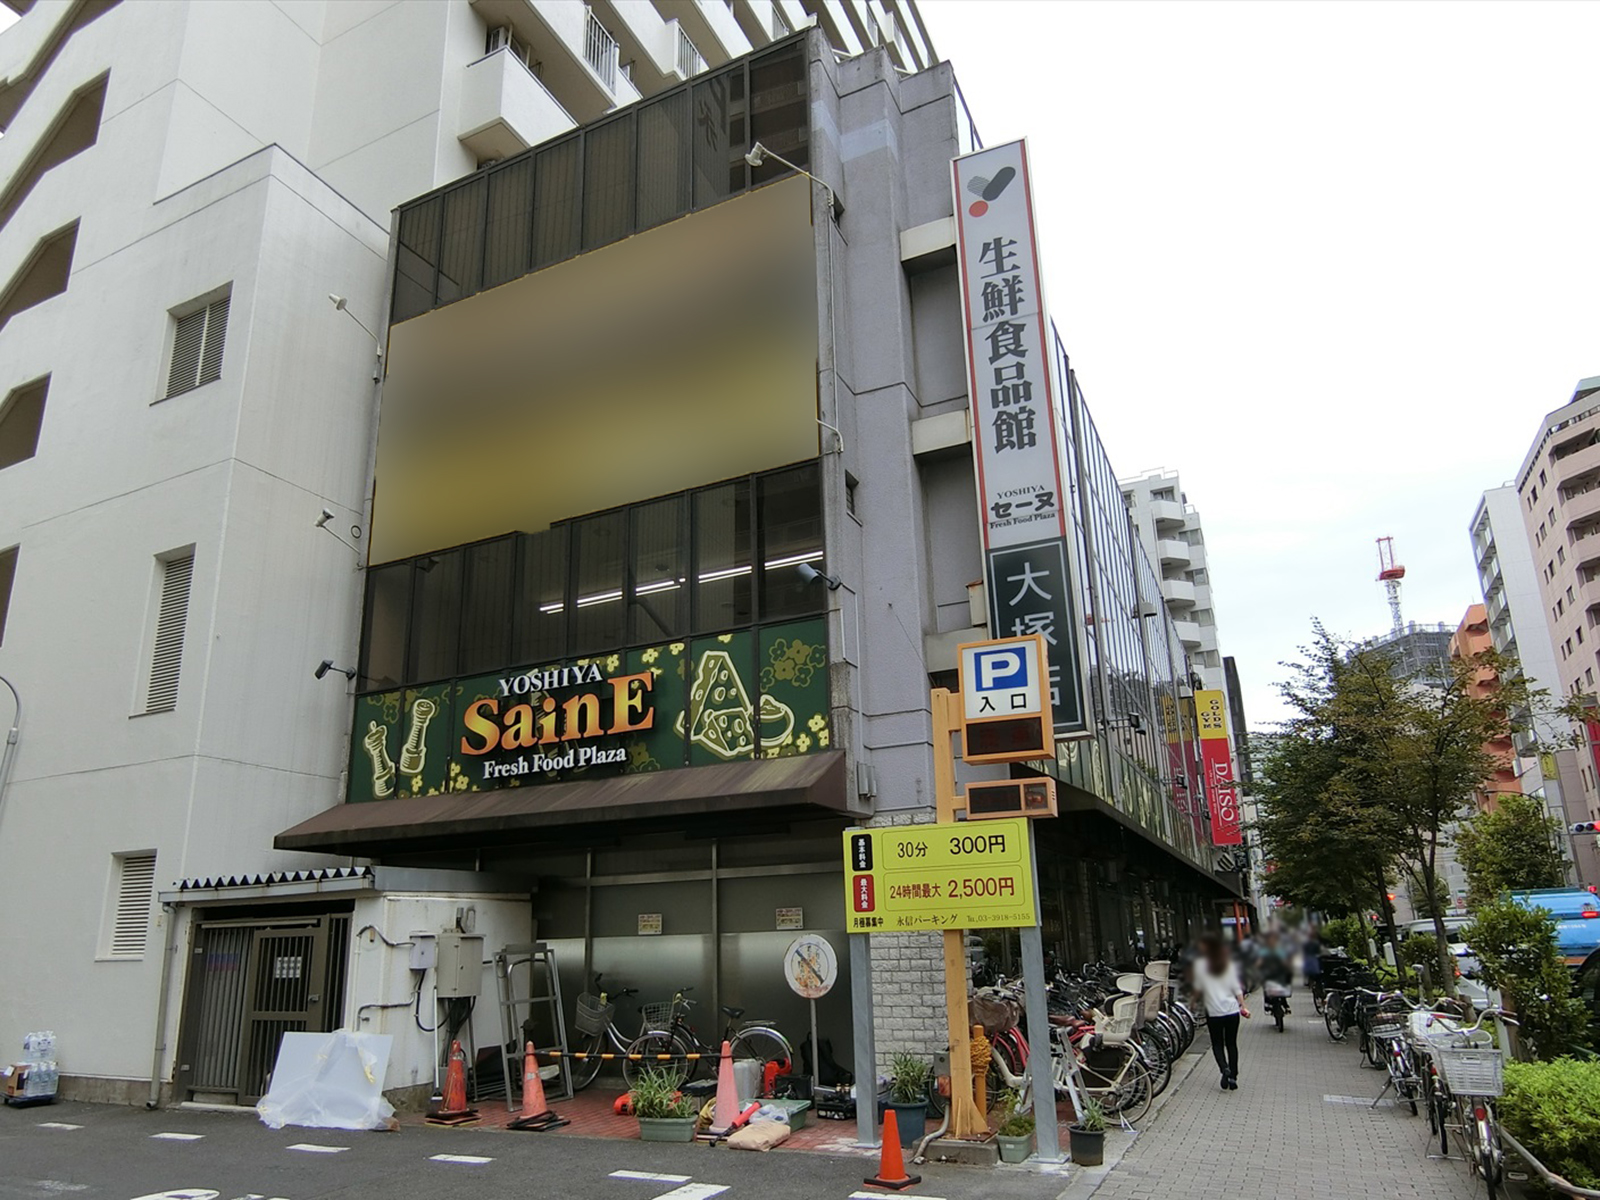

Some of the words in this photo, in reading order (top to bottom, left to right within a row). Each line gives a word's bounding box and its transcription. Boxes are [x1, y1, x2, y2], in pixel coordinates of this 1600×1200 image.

[978, 236, 1037, 455] 生鮮食品館
[991, 491, 1055, 519] セーヌ
[996, 485, 1045, 499] YOSHIYA
[990, 519, 1012, 529] Fresh
[1012, 515, 1033, 525] Food
[1034, 512, 1056, 521] Plaza
[1007, 562, 1060, 706] 大塚
[499, 663, 603, 697] YOSHIYA
[980, 652, 1021, 689] P
[461, 671, 655, 756] SainE
[979, 693, 1027, 713] 入口
[483, 756, 530, 779] Fresh
[531, 749, 575, 773] Food
[577, 745, 627, 766] Plaza
[1215, 763, 1234, 821] DAISO
[897, 841, 928, 858] 30分
[949, 834, 1006, 855] 300円
[889, 883, 942, 900] 24時間最大
[947, 877, 1015, 900] 2,500円
